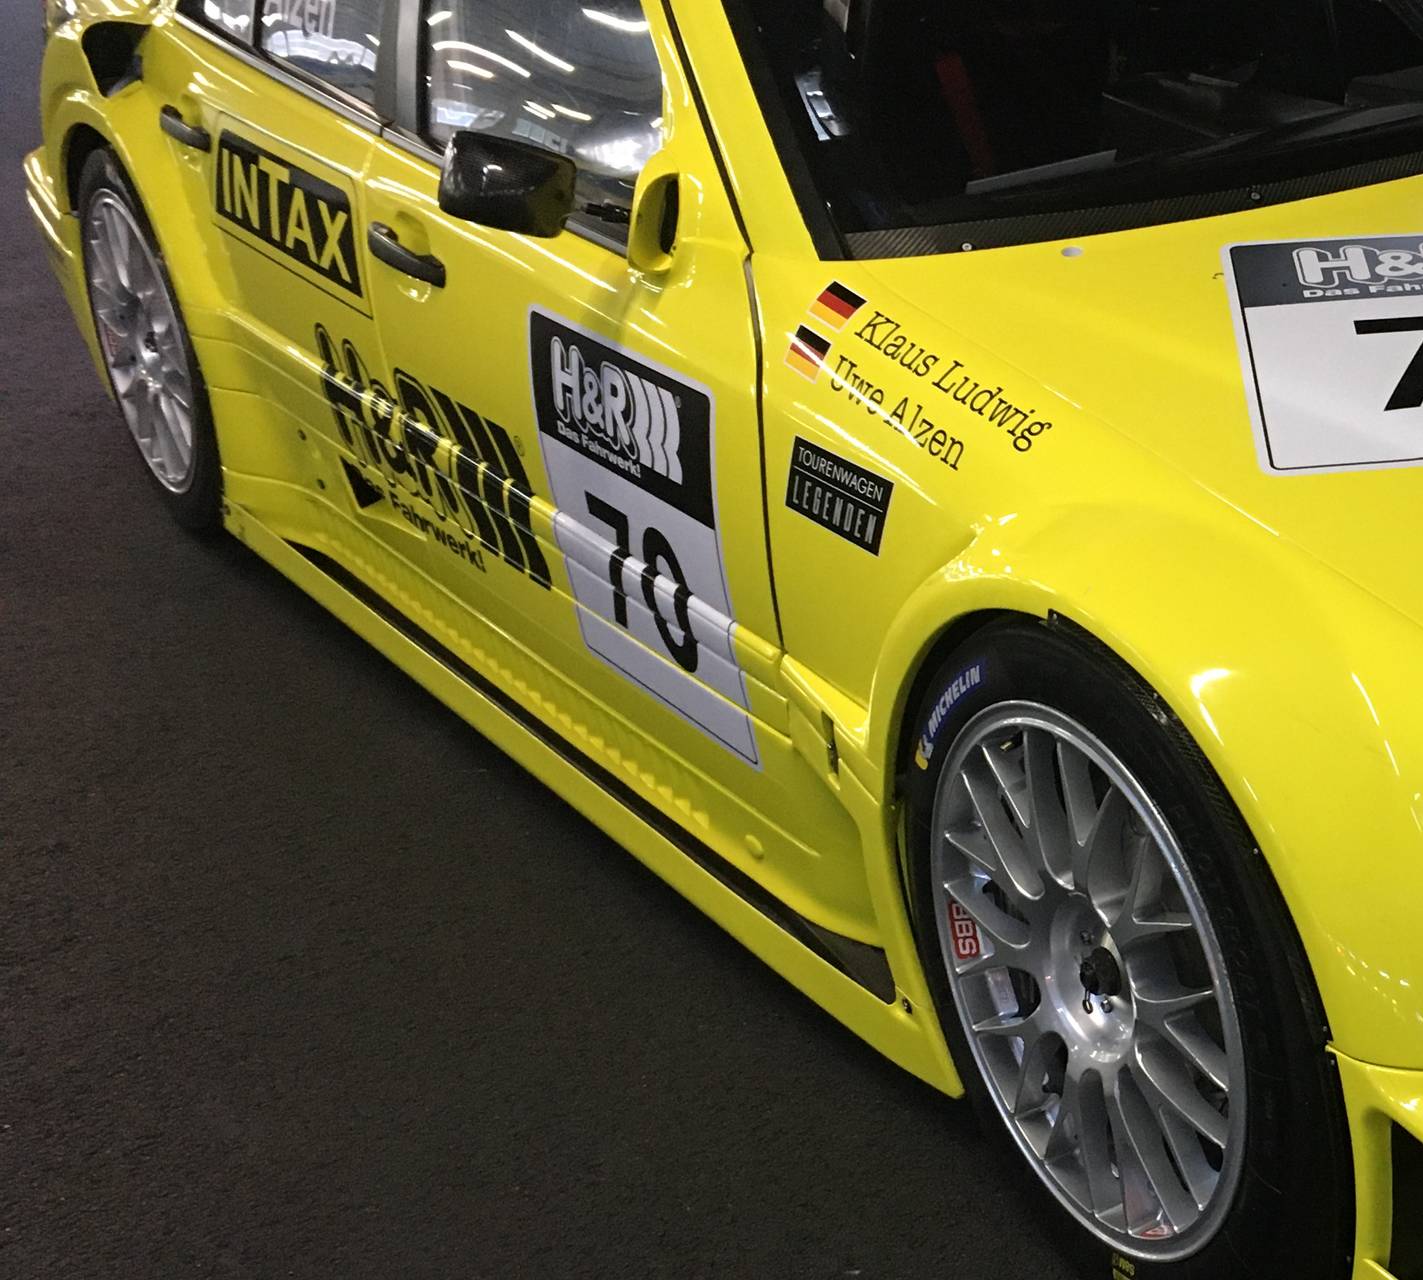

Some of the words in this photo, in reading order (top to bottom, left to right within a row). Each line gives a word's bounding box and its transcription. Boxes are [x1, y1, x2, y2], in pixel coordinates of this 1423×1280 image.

[221, 147, 353, 284] INTAX
[1302, 287, 1360, 298] Das
[552, 337, 639, 459] H&R
[830, 355, 885, 414] Uwe
[883, 396, 965, 471] Alzen
[853, 311, 940, 377] Klaus
[931, 360, 1053, 452] Ludwig
[557, 420, 579, 444] Das
[581, 435, 641, 479] Fahrwerk!
[797, 446, 884, 502] TOURENWAGEN
[389, 490, 487, 573] Fahrwerk!
[791, 475, 878, 544] LEGENDEN
[584, 489, 699, 673] 70
[927, 664, 981, 738] MICHELIN
